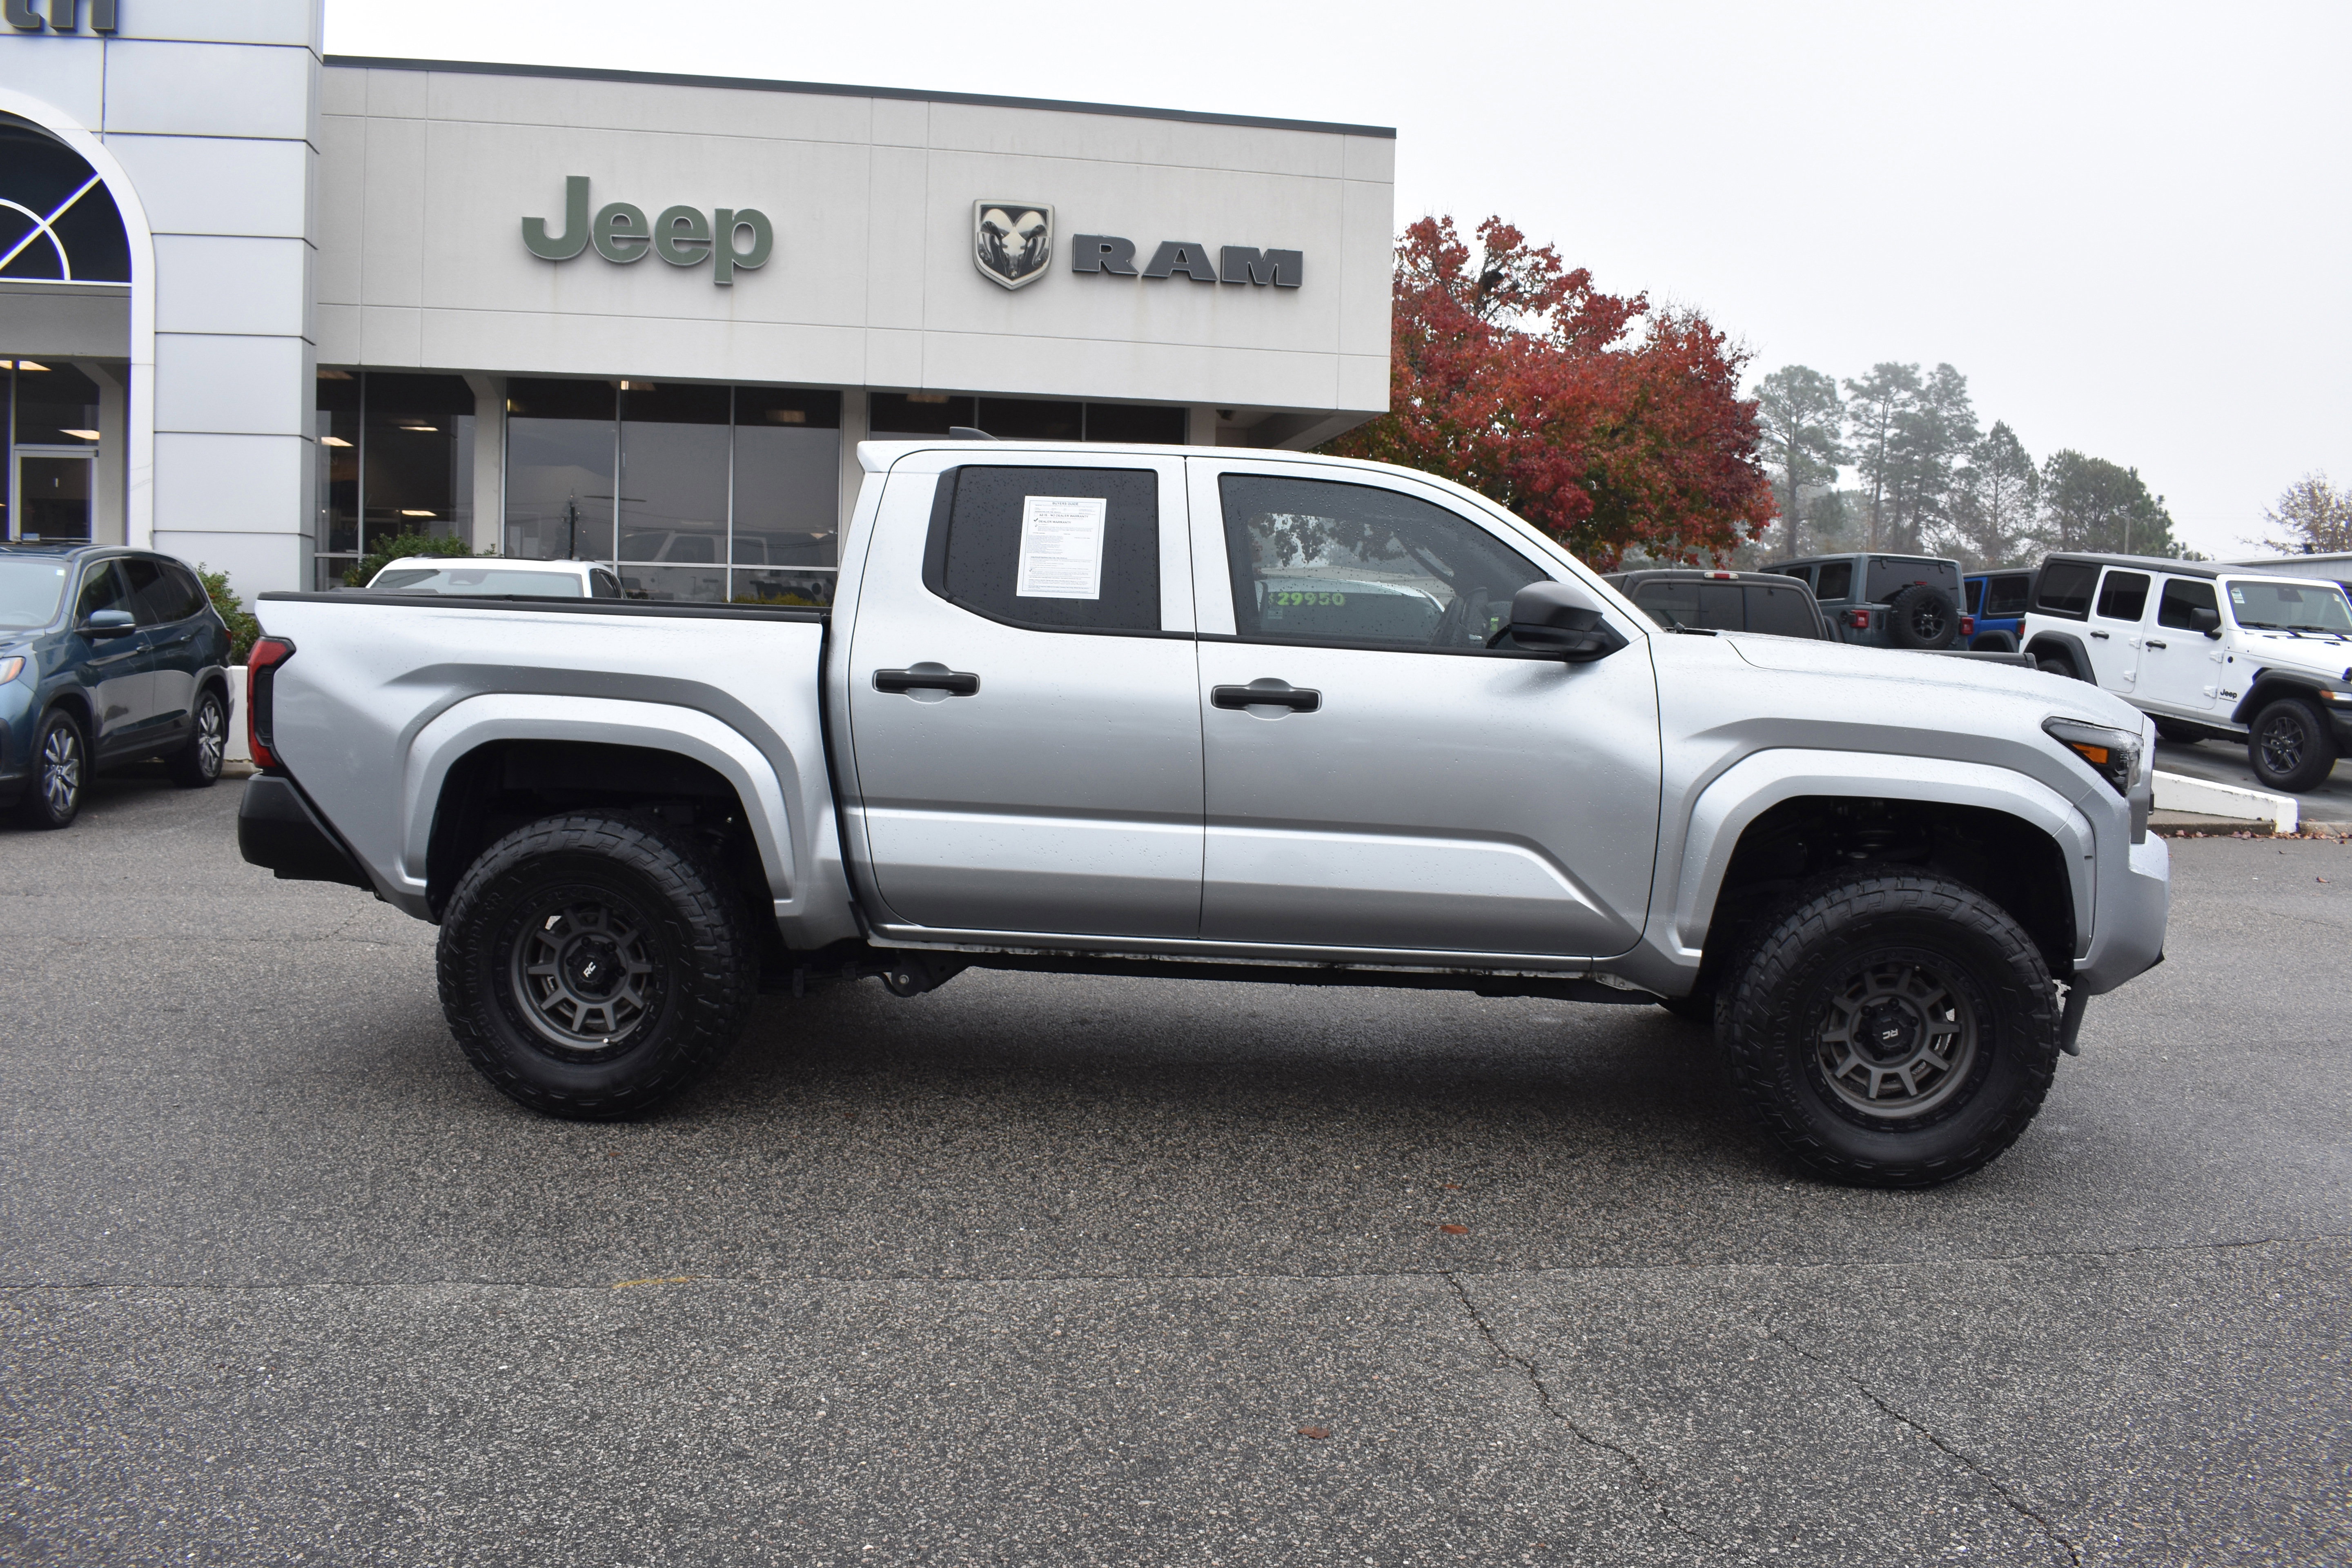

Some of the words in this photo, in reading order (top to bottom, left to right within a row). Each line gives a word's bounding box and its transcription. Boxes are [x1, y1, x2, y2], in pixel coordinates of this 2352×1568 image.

[521, 175, 774, 285] Jeep
[1072, 234, 1303, 289] RAM
[2220, 688, 2237, 699] Jeep
[583, 961, 596, 978] RC
[1882, 1028, 1898, 1040] RC
